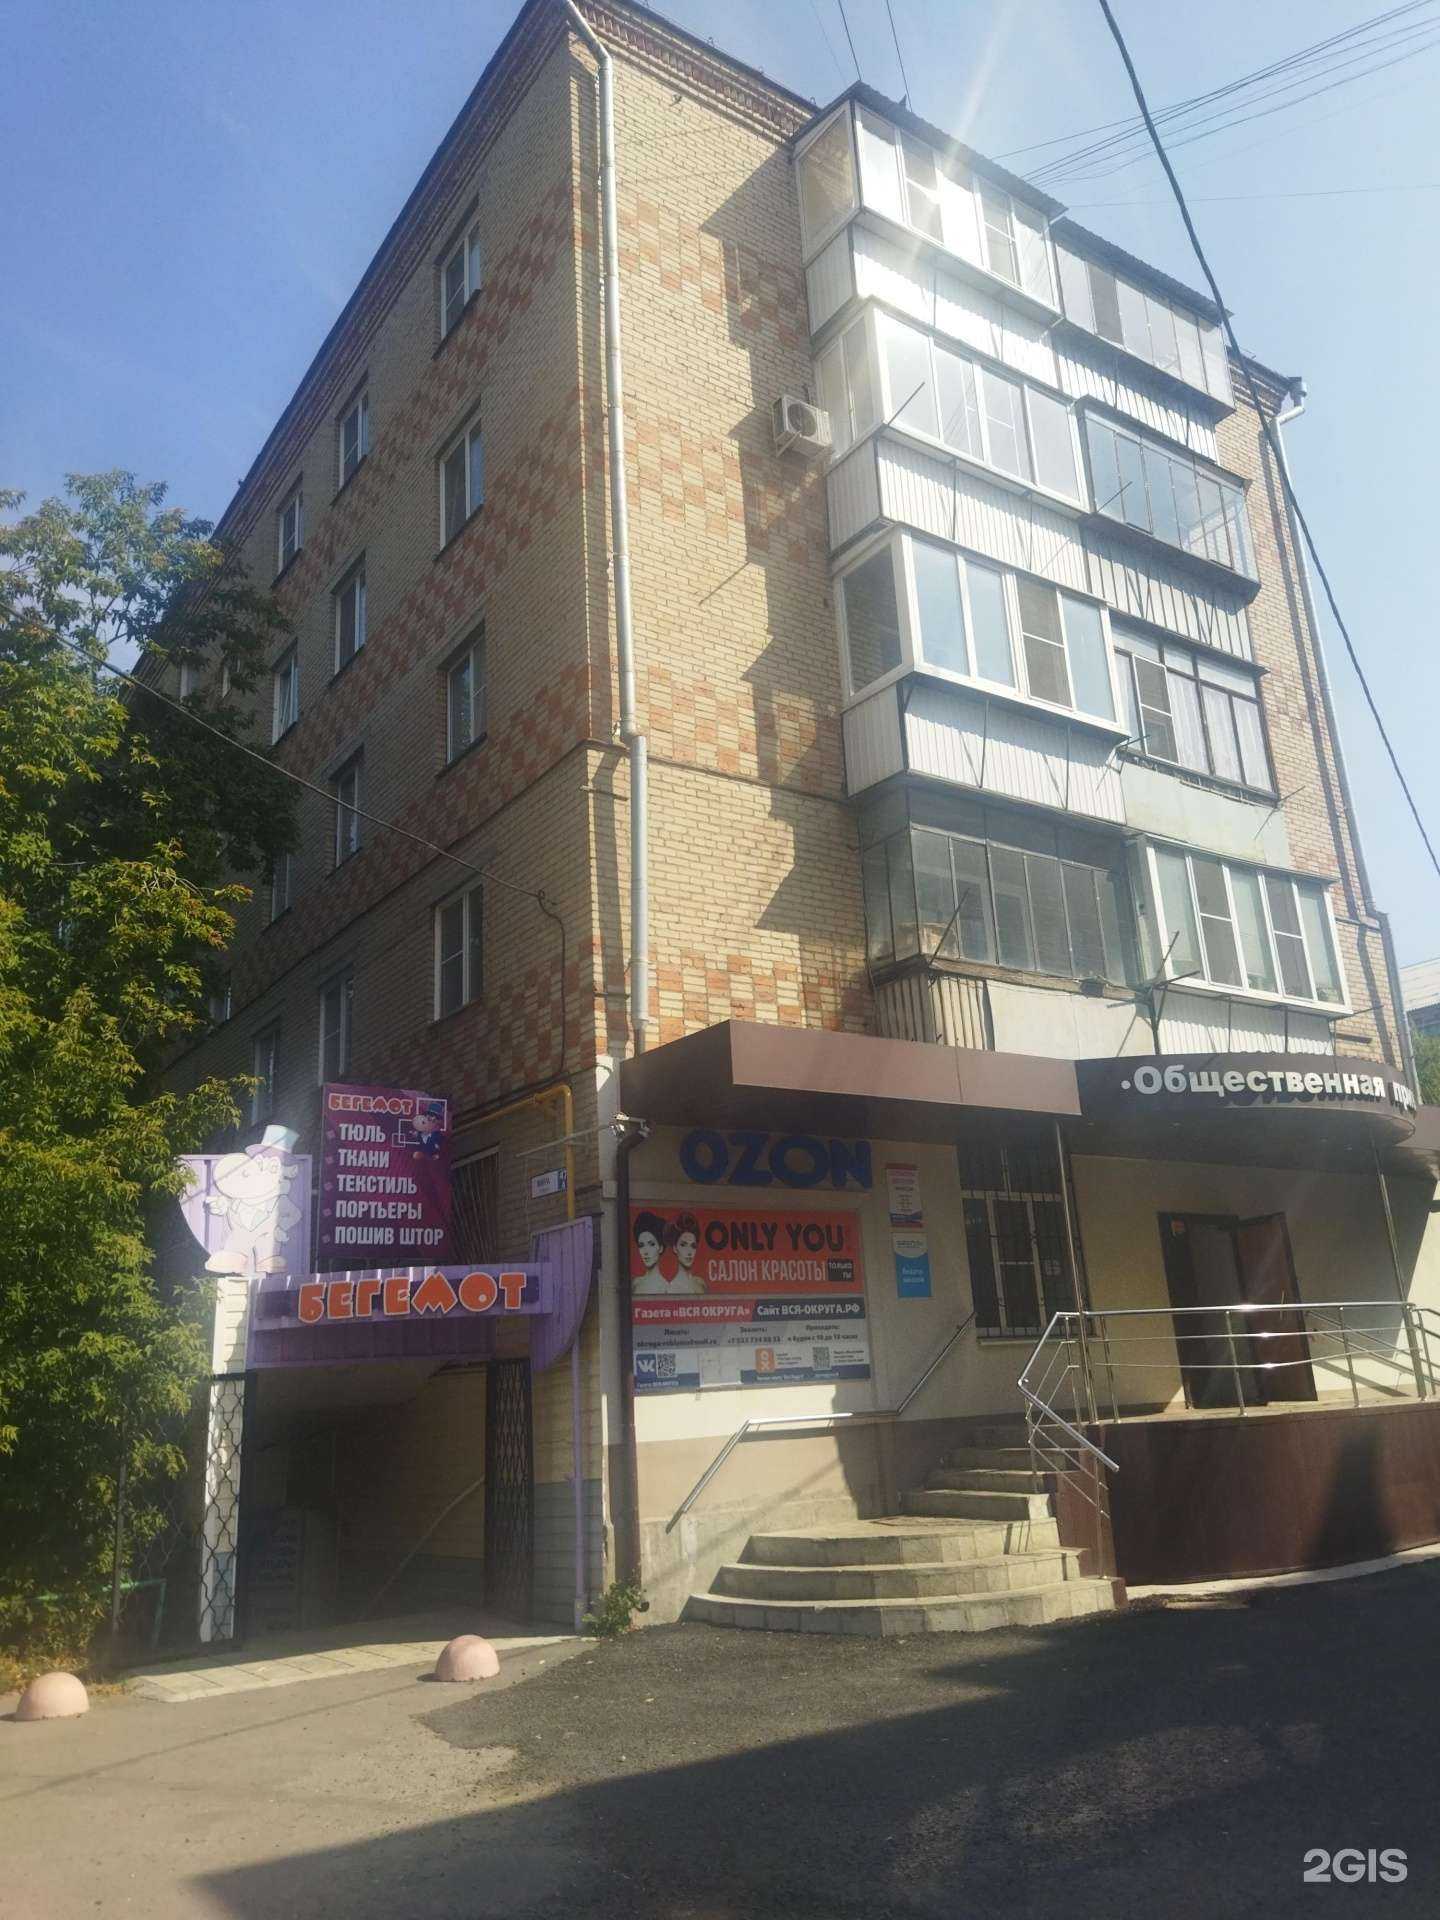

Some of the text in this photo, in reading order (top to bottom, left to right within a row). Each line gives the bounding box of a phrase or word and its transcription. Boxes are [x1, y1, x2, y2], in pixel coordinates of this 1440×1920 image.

[1133, 1064, 1386, 1099] Общественная
[328, 1093, 413, 1115] БЕГЕМОТ
[339, 1123, 386, 1142] ТЮЛЬ
[337, 1148, 390, 1169] ТКАНИ
[679, 1128, 873, 1190] OZON
[336, 1174, 418, 1195] ТЕКСТИЛЬ
[335, 1199, 422, 1220] ПОРТЬЕРЫ
[334, 1226, 444, 1246] ПОШИВ ШТОР
[705, 1220, 844, 1252] ONLY YOU
[708, 1259, 827, 1282] САЛОН КРАСОТЫ
[297, 1271, 527, 1324] БЕГЕМОТ
[634, 1305, 750, 1319] Газета «ВСЯ ОКРУГА»
[757, 1303, 861, 1316] Сайт ВСЯ-ОКРУГА.РФ
